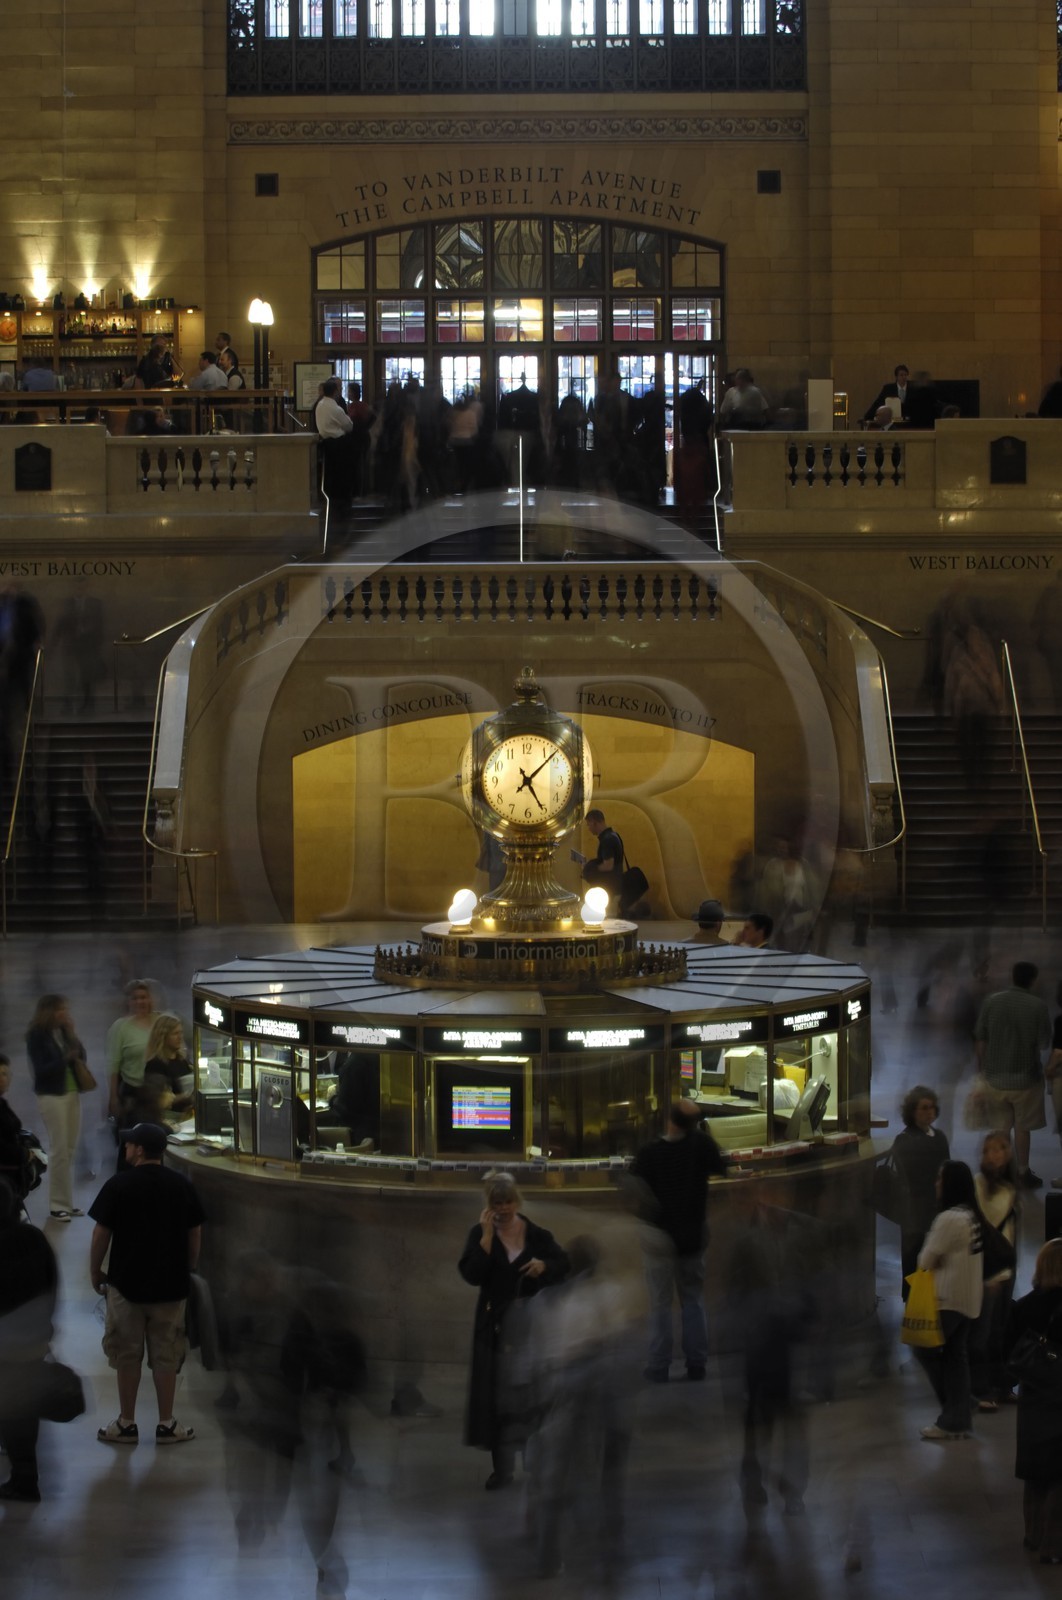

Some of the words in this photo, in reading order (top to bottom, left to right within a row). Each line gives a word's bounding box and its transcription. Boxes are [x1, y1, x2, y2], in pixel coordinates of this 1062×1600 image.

[355, 181, 388, 201] TO
[403, 167, 564, 191] VANDERBILT
[581, 170, 682, 199] AVENUE
[336, 203, 387, 228] THE
[403, 189, 533, 214] CAMPBELL
[550, 190, 701, 226] APARTMENT
[909, 556, 960, 570] WEST
[966, 555, 1054, 570] BALCONY
[48, 561, 136, 576] BALCONY
[576, 692, 639, 711] TRACKS
[644, 702, 666, 717] 100
[671, 707, 692, 723] TO
[302, 711, 367, 742] DINING
[372, 692, 473, 720] CONCOURSE
[506, 749, 514, 760] 11
[522, 743, 532, 755] 12
[542, 747, 546, 758] 1
[494, 761, 504, 772] 10
[492, 776, 499, 789] 9
[556, 776, 564, 787] 3
[497, 794, 503, 805] 8
[552, 792, 560, 803] 4
[509, 804, 515, 815] 7
[524, 808, 532, 819] 6
[494, 941, 597, 960] Information
[263, 1076, 290, 1086] CLOSED
